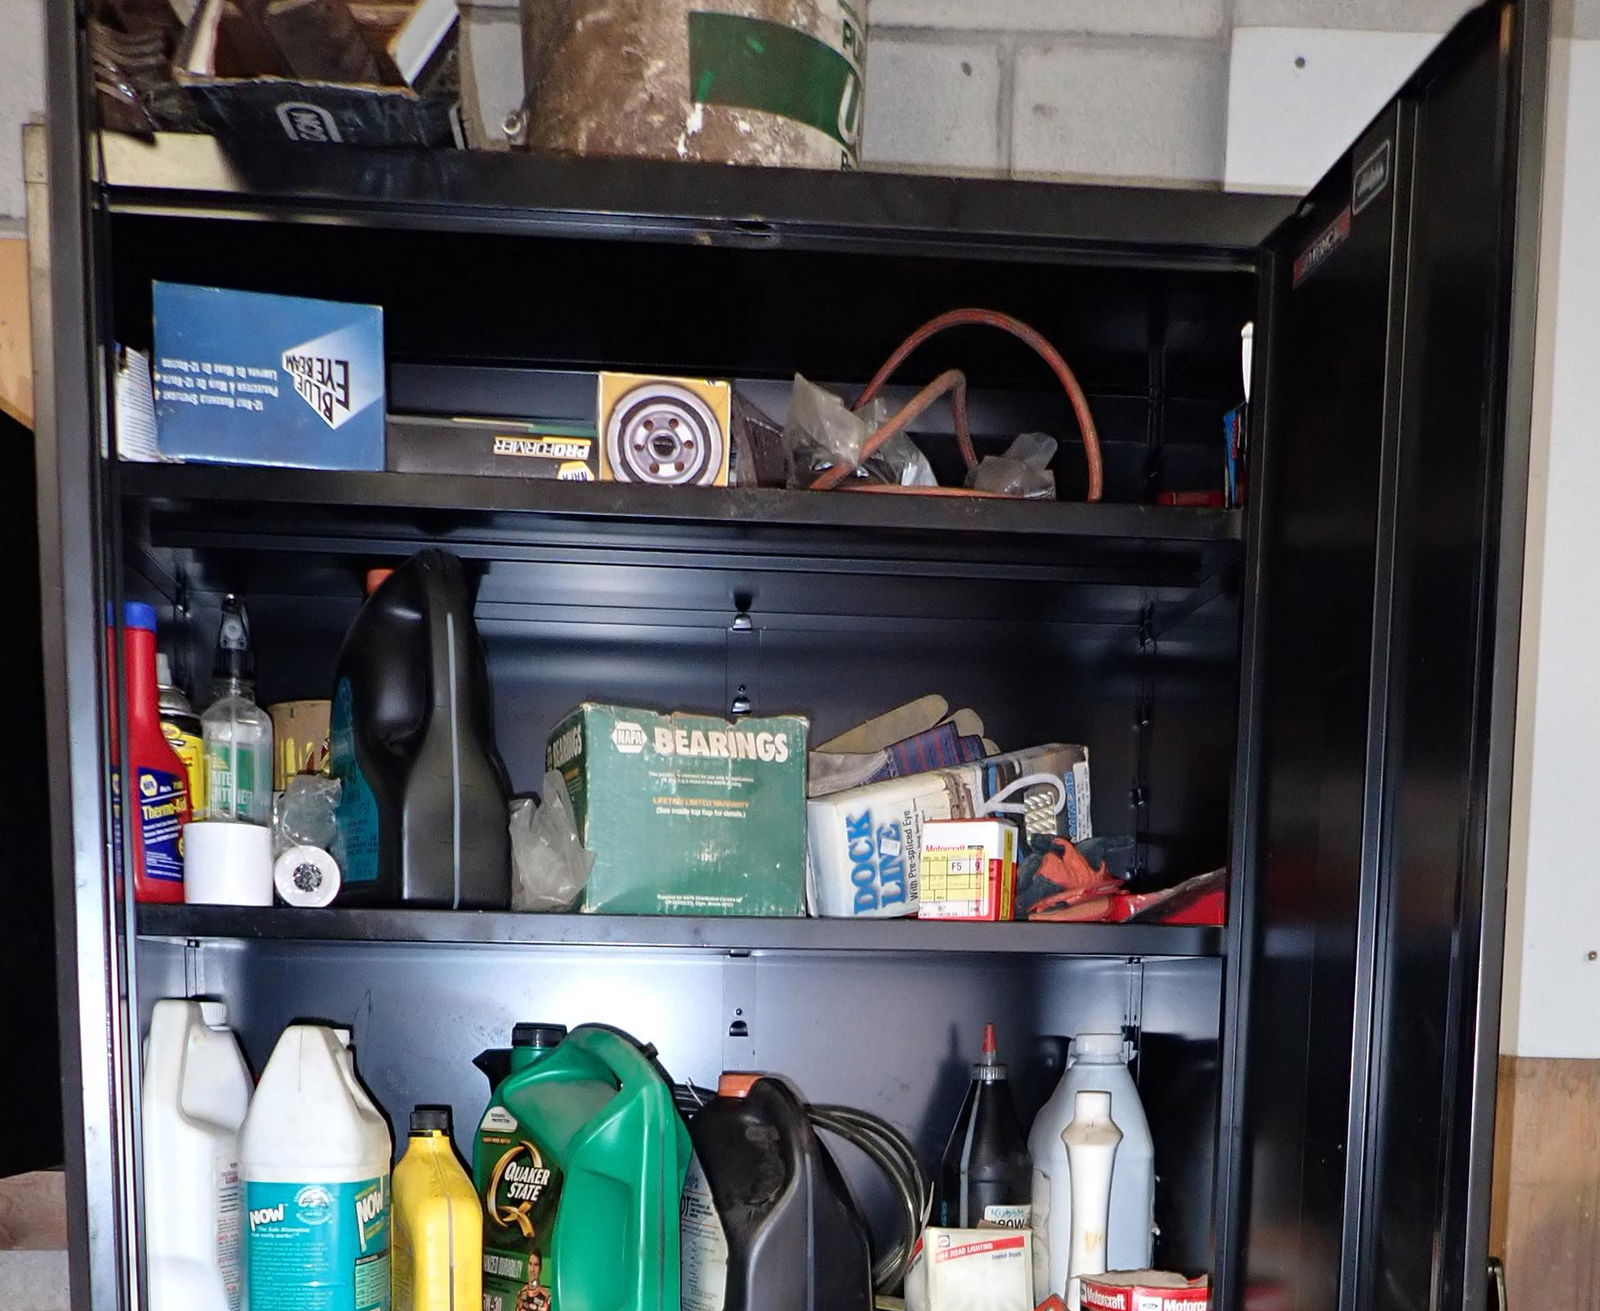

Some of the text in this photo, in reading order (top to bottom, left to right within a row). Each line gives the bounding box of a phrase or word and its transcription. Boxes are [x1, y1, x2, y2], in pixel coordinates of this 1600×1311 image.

[286, 354, 350, 412] EYE BEAM
[294, 375, 334, 423] BLUE
[494, 439, 590, 459] PROFORMER
[616, 727, 789, 762] NAPA BEARINGS
[845, 808, 879, 914] DOCK
[876, 821, 907, 908] LINE
[902, 809, 920, 901] With Pre-spliced Eye
[504, 1161, 550, 1186] QUAKER
[507, 1182, 542, 1201] STATE
[1087, 1287, 1127, 1311] Motorcraft
